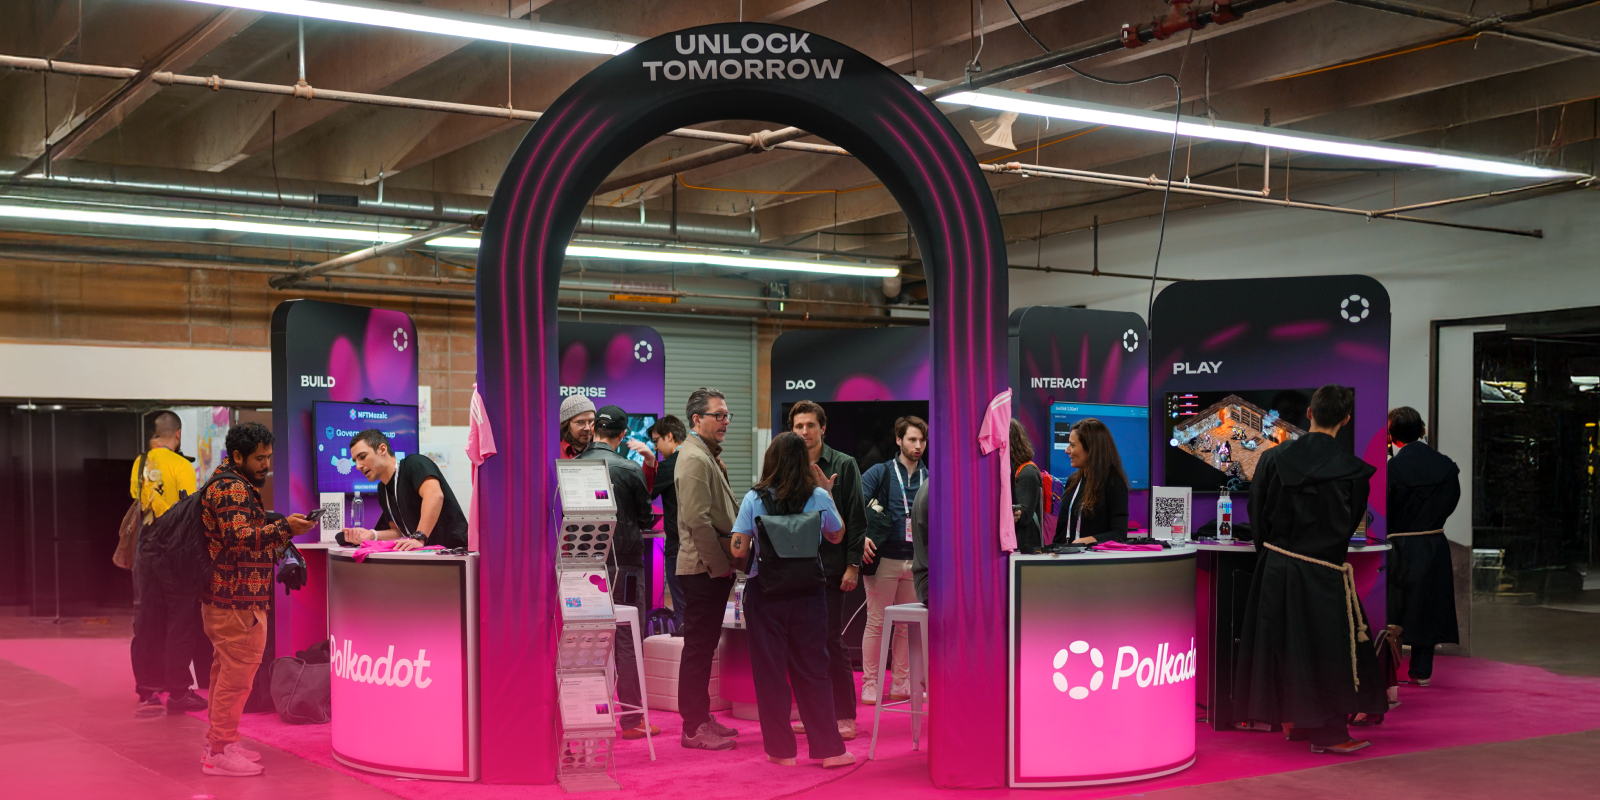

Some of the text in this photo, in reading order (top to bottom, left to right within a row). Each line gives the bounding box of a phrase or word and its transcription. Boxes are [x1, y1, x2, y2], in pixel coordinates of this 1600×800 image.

[675, 32, 811, 55] UNLOCK
[642, 58, 844, 82] TOMORROW
[1173, 361, 1223, 375] PLAY
[300, 375, 336, 388] BUILD
[785, 379, 816, 390] DAO
[1031, 377, 1087, 389] INTERACT
[330, 634, 433, 689] Polkadot
